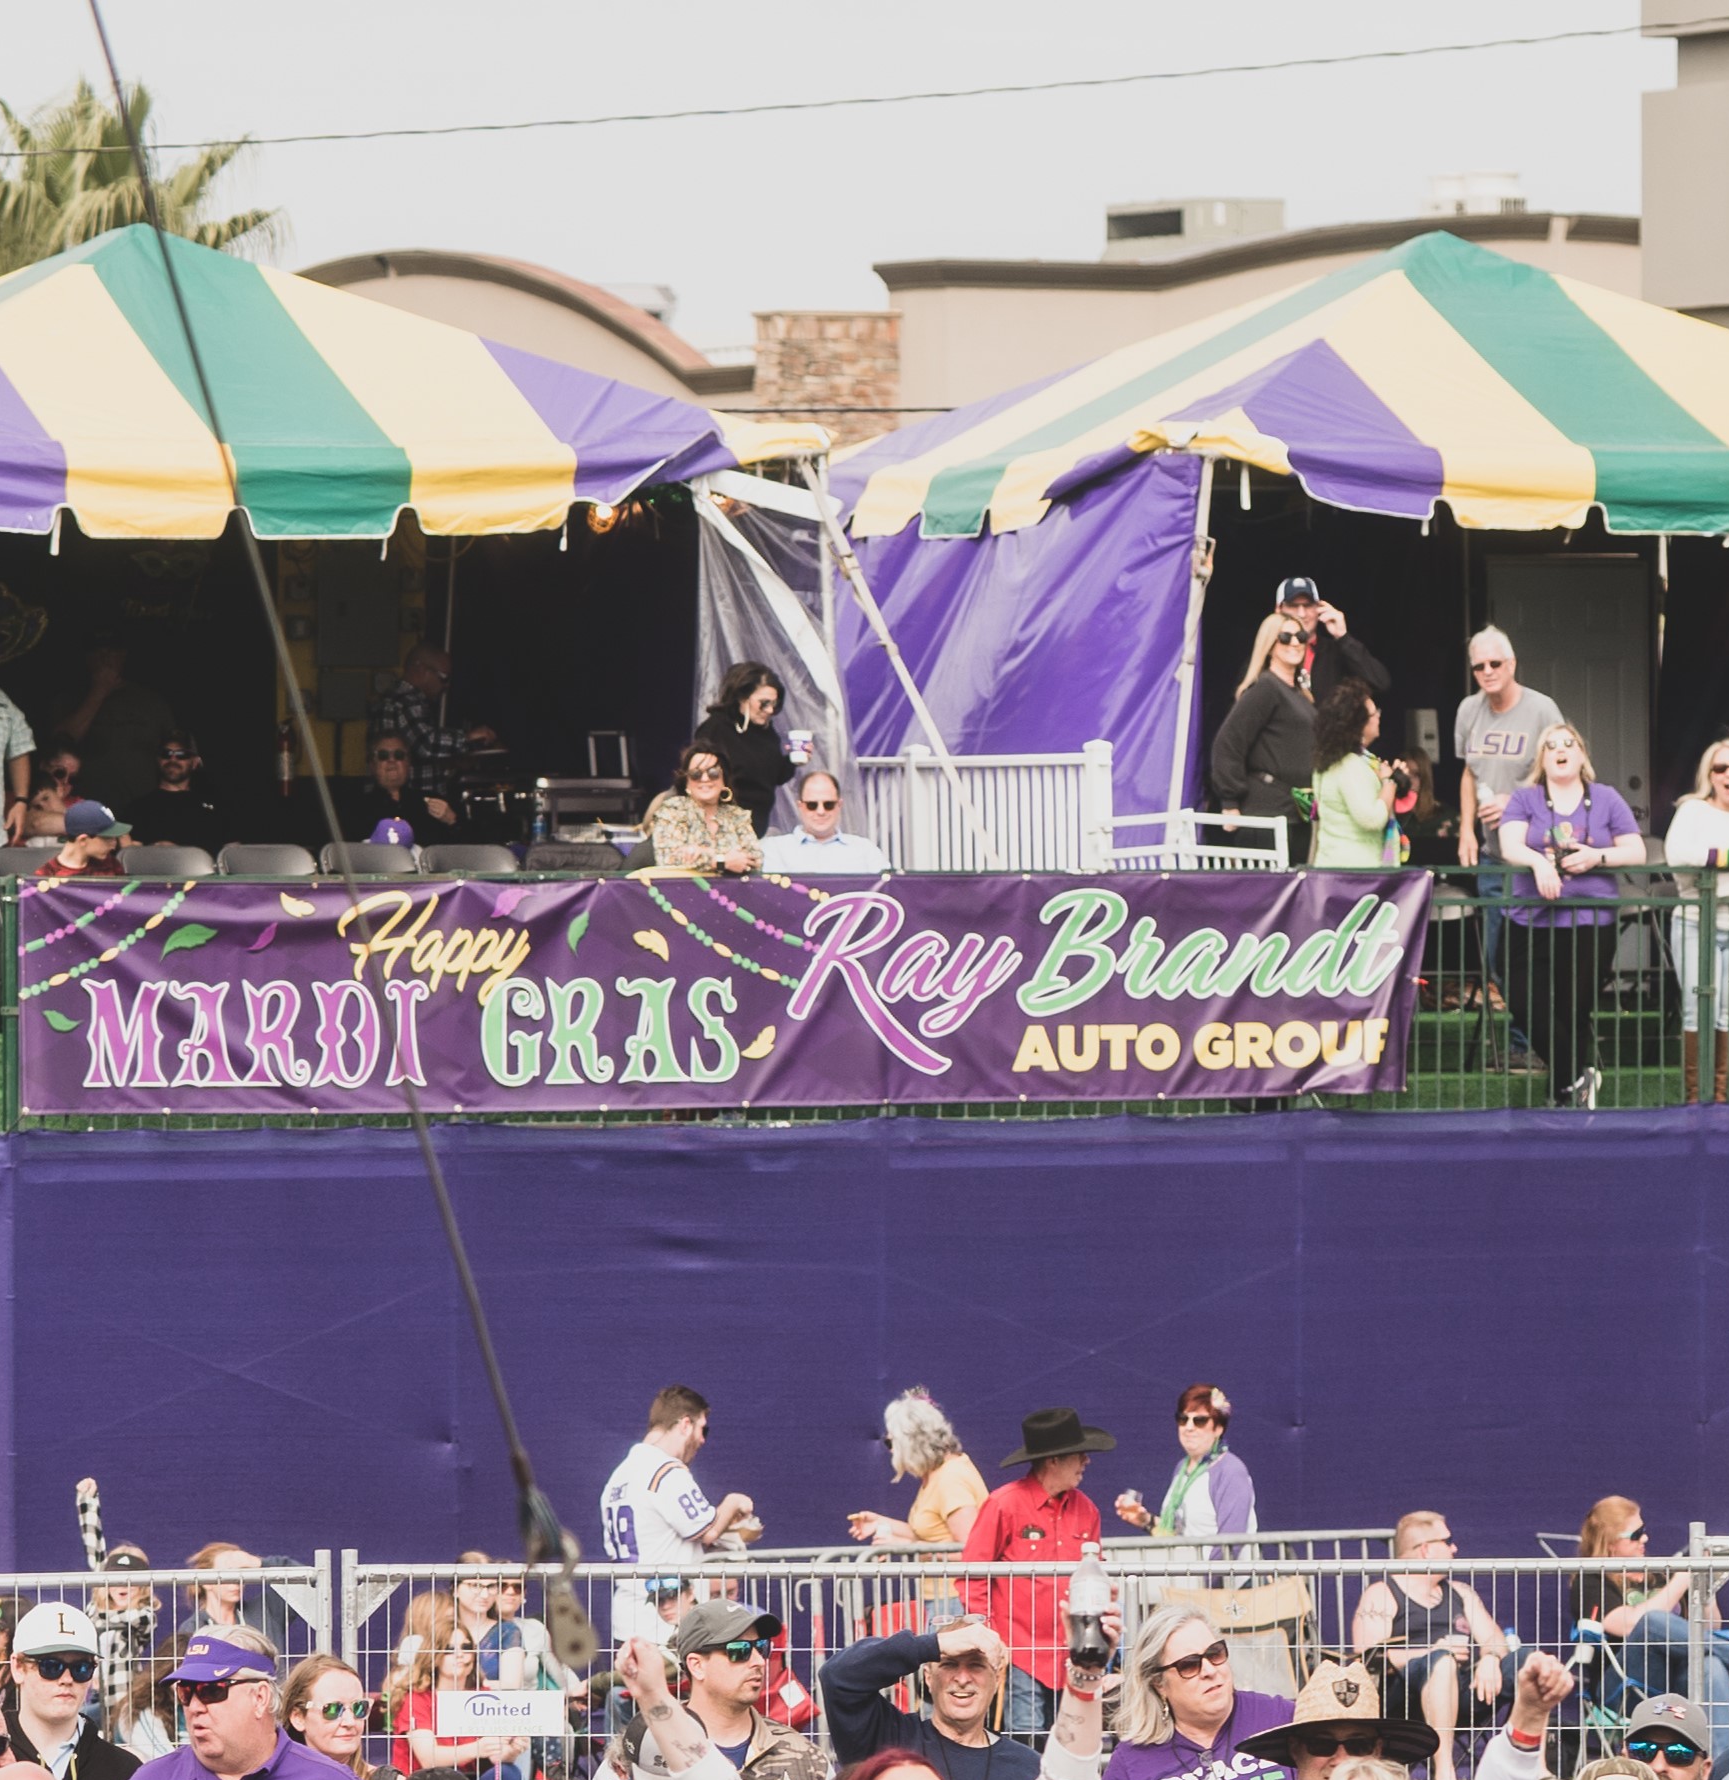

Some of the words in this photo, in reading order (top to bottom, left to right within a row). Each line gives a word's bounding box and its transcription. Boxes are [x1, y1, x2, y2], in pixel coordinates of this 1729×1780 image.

[1466, 731, 1527, 757] LSU
[337, 891, 530, 1005] Happy
[787, 890, 1023, 1077] Ray
[1017, 887, 1405, 1018] Brandt
[80, 978, 430, 1088] MARDI
[480, 976, 740, 1087] GRAS
[1011, 1022, 1181, 1074] AUTO
[57, 1612, 75, 1635] L
[472, 1702, 531, 1716] United
